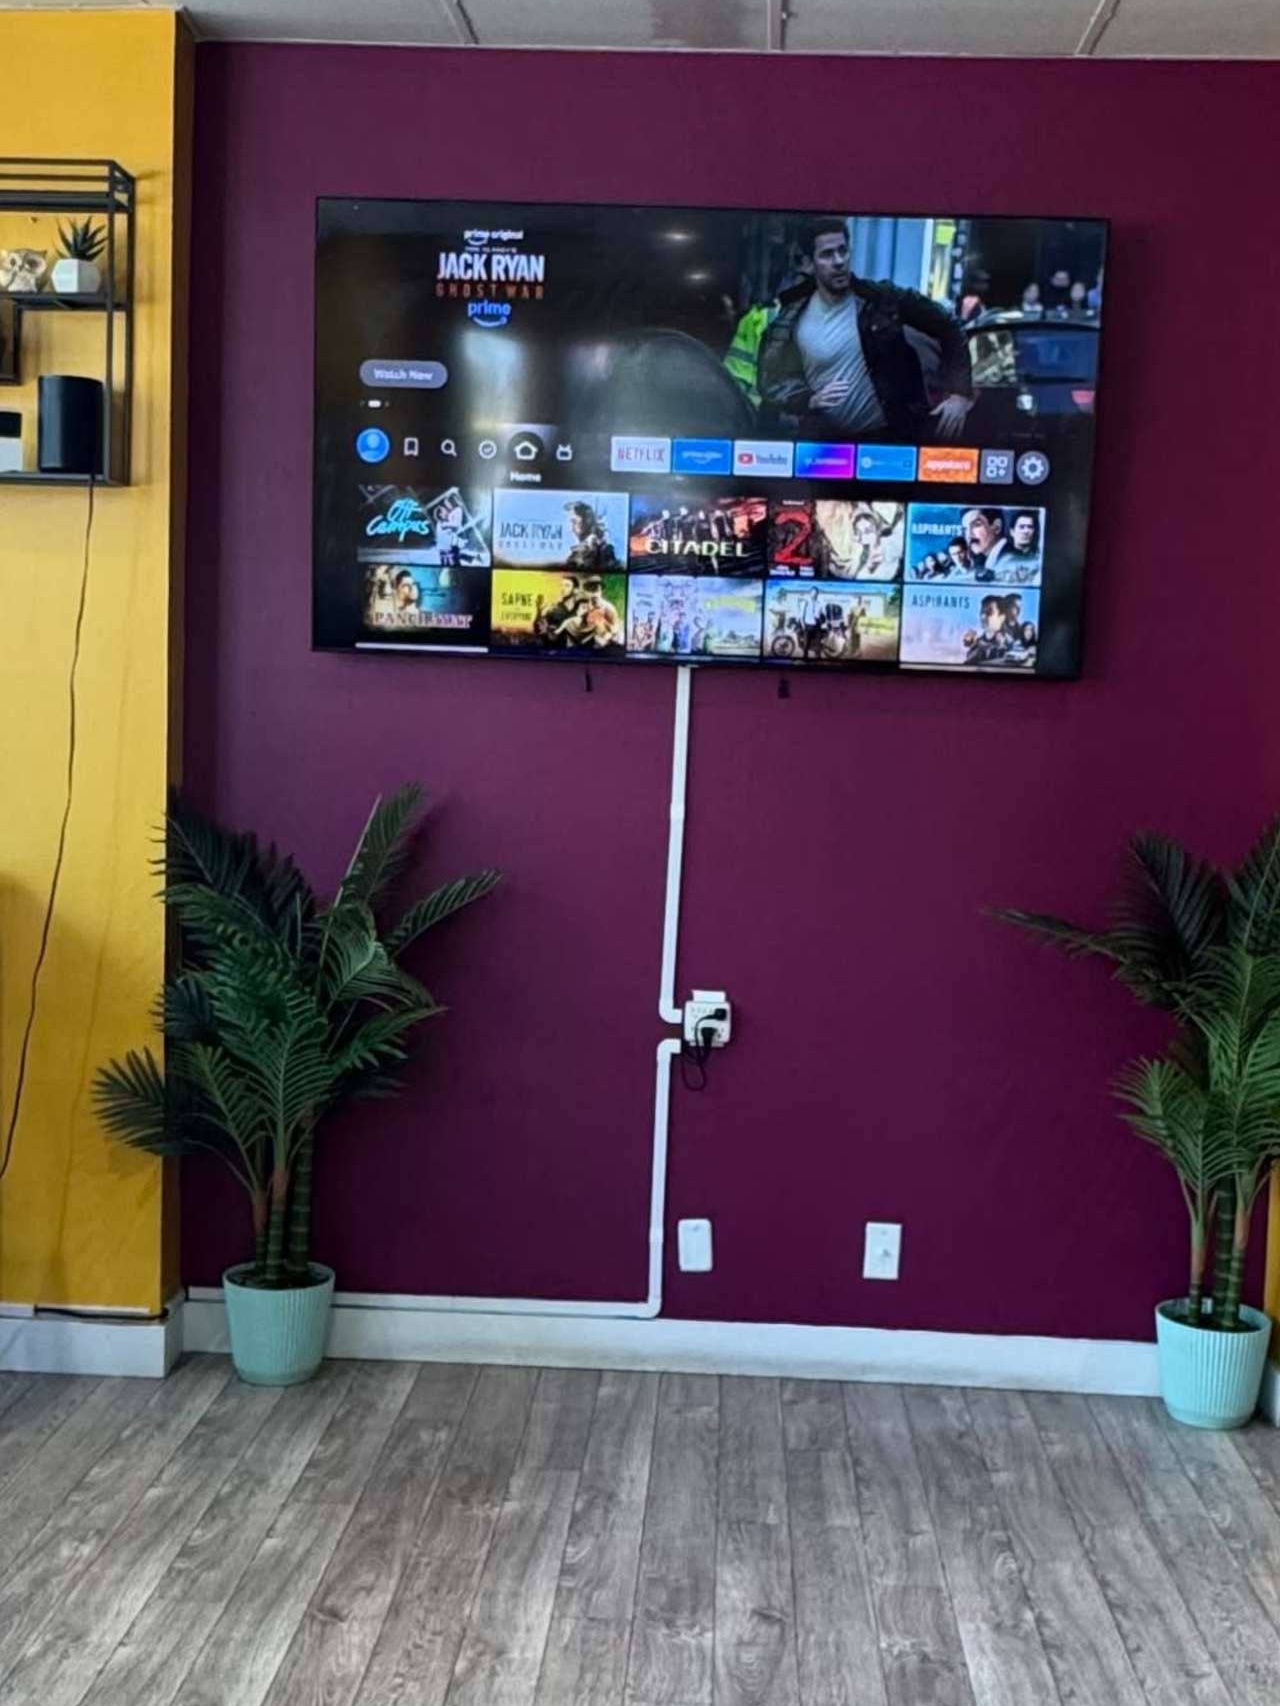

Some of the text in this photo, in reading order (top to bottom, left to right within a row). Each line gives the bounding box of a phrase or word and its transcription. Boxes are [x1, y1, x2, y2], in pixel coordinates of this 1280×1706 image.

[437, 252, 545, 282] JACK RYAN
[436, 282, 545, 300] GHOST WAR
[468, 300, 511, 317] prime
[373, 367, 434, 381] Watch Now
[617, 447, 666, 463] NETFLIX
[509, 471, 542, 483] Home
[387, 496, 427, 523] Off
[366, 515, 432, 542] Campus
[499, 521, 529, 539] JACK
[911, 522, 963, 537] ASPIRANTS
[645, 540, 750, 558] CITADEL
[501, 592, 533, 607] SAPNE
[911, 594, 971, 609] ASPIRANTS
